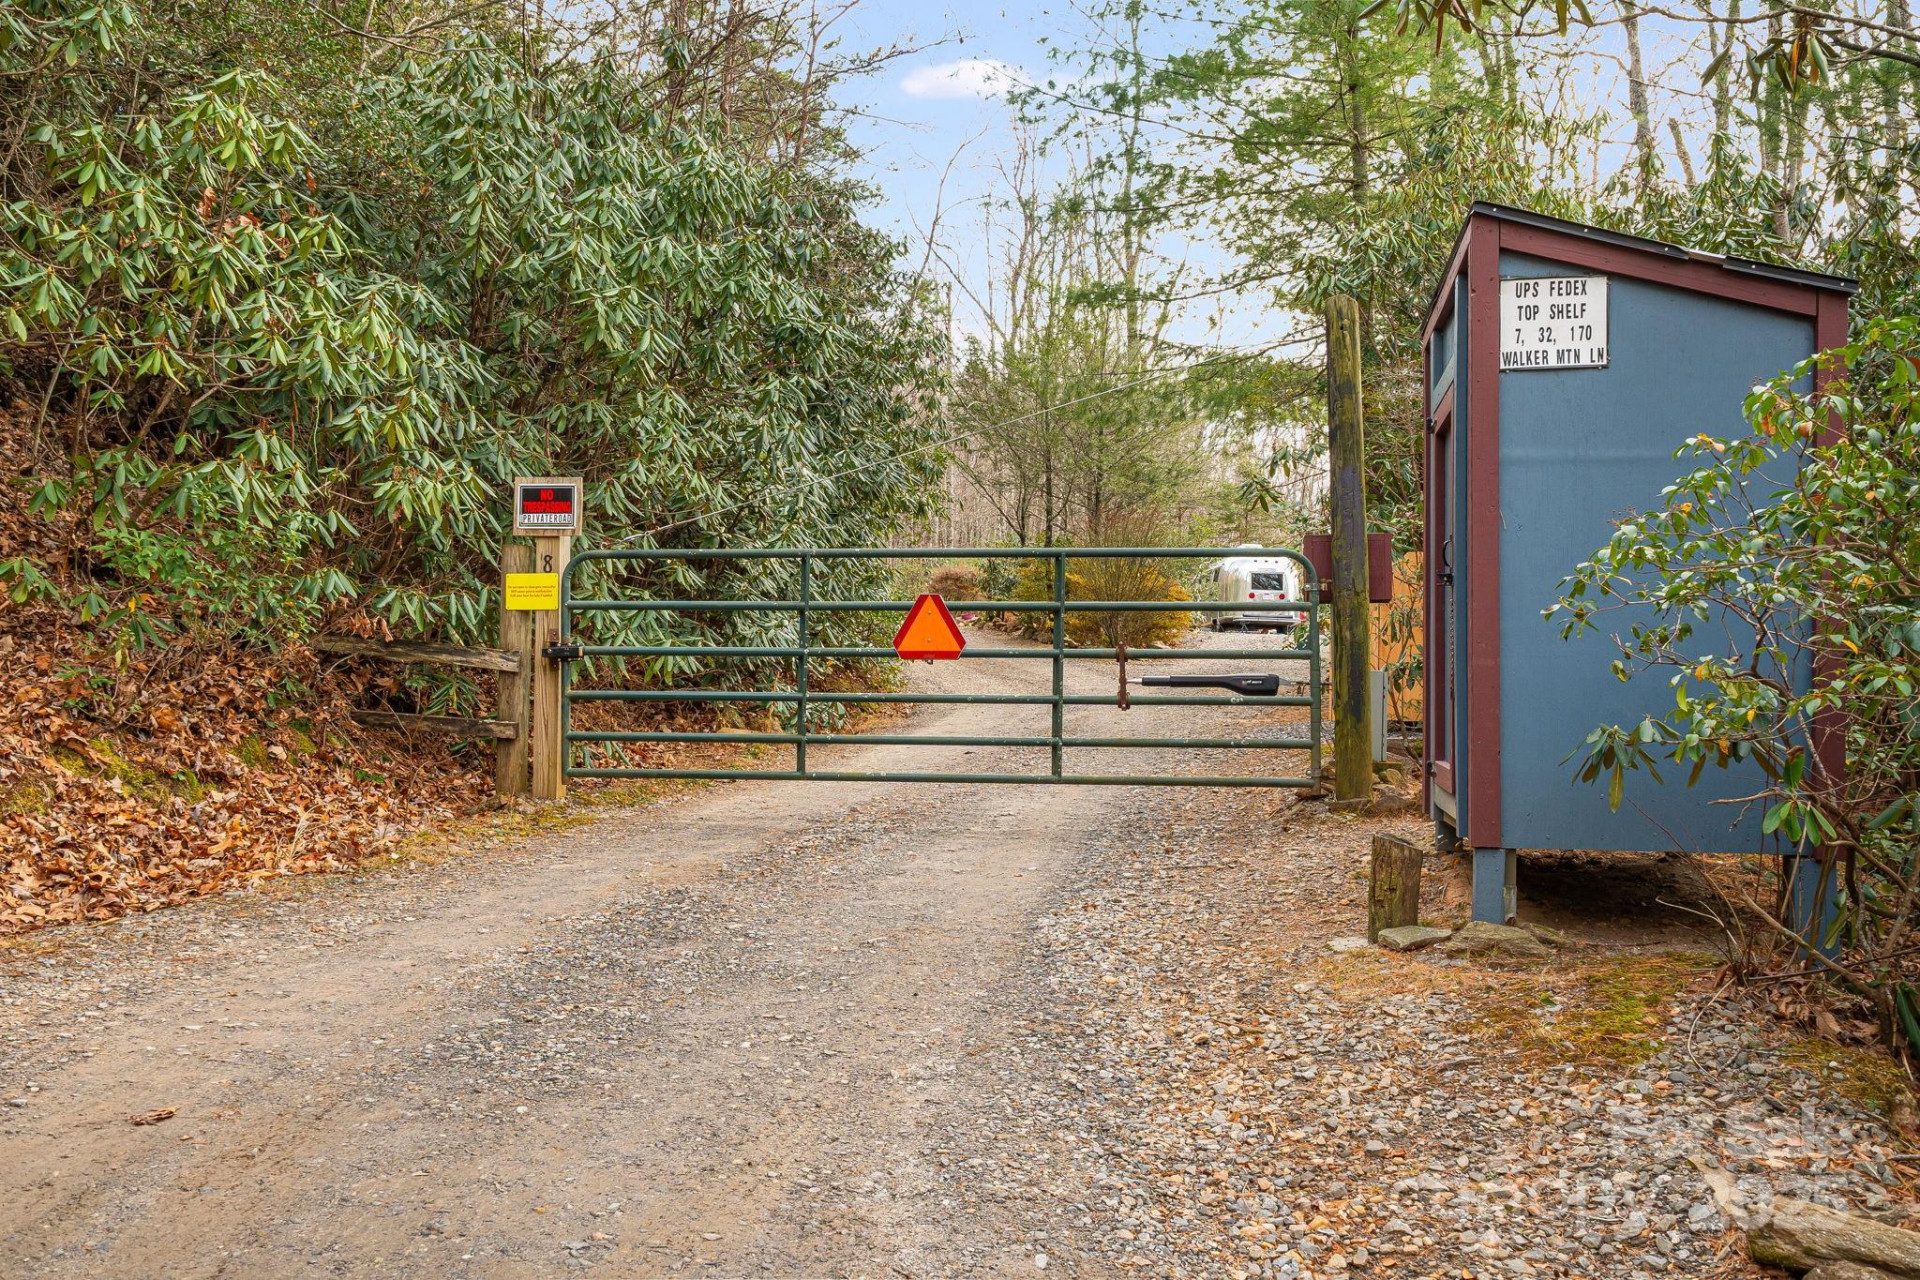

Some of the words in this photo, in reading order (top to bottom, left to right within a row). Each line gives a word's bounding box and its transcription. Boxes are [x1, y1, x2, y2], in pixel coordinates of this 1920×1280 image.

[1515, 281, 1539, 298] UPS
[1549, 279, 1587, 297] FEDEX
[1517, 304, 1539, 321] TOP
[1549, 303, 1587, 320] SHELF
[1515, 328, 1525, 346] 7,
[1538, 326, 1557, 345] 32,
[1570, 324, 1592, 342] 170
[1502, 349, 1549, 367] WALKER
[1556, 348, 1581, 365] MTN
[1590, 347, 1604, 364] LN
[540, 488, 554, 501] NO
[523, 500, 571, 513] TRESPASSING
[543, 554, 553, 573] 8
